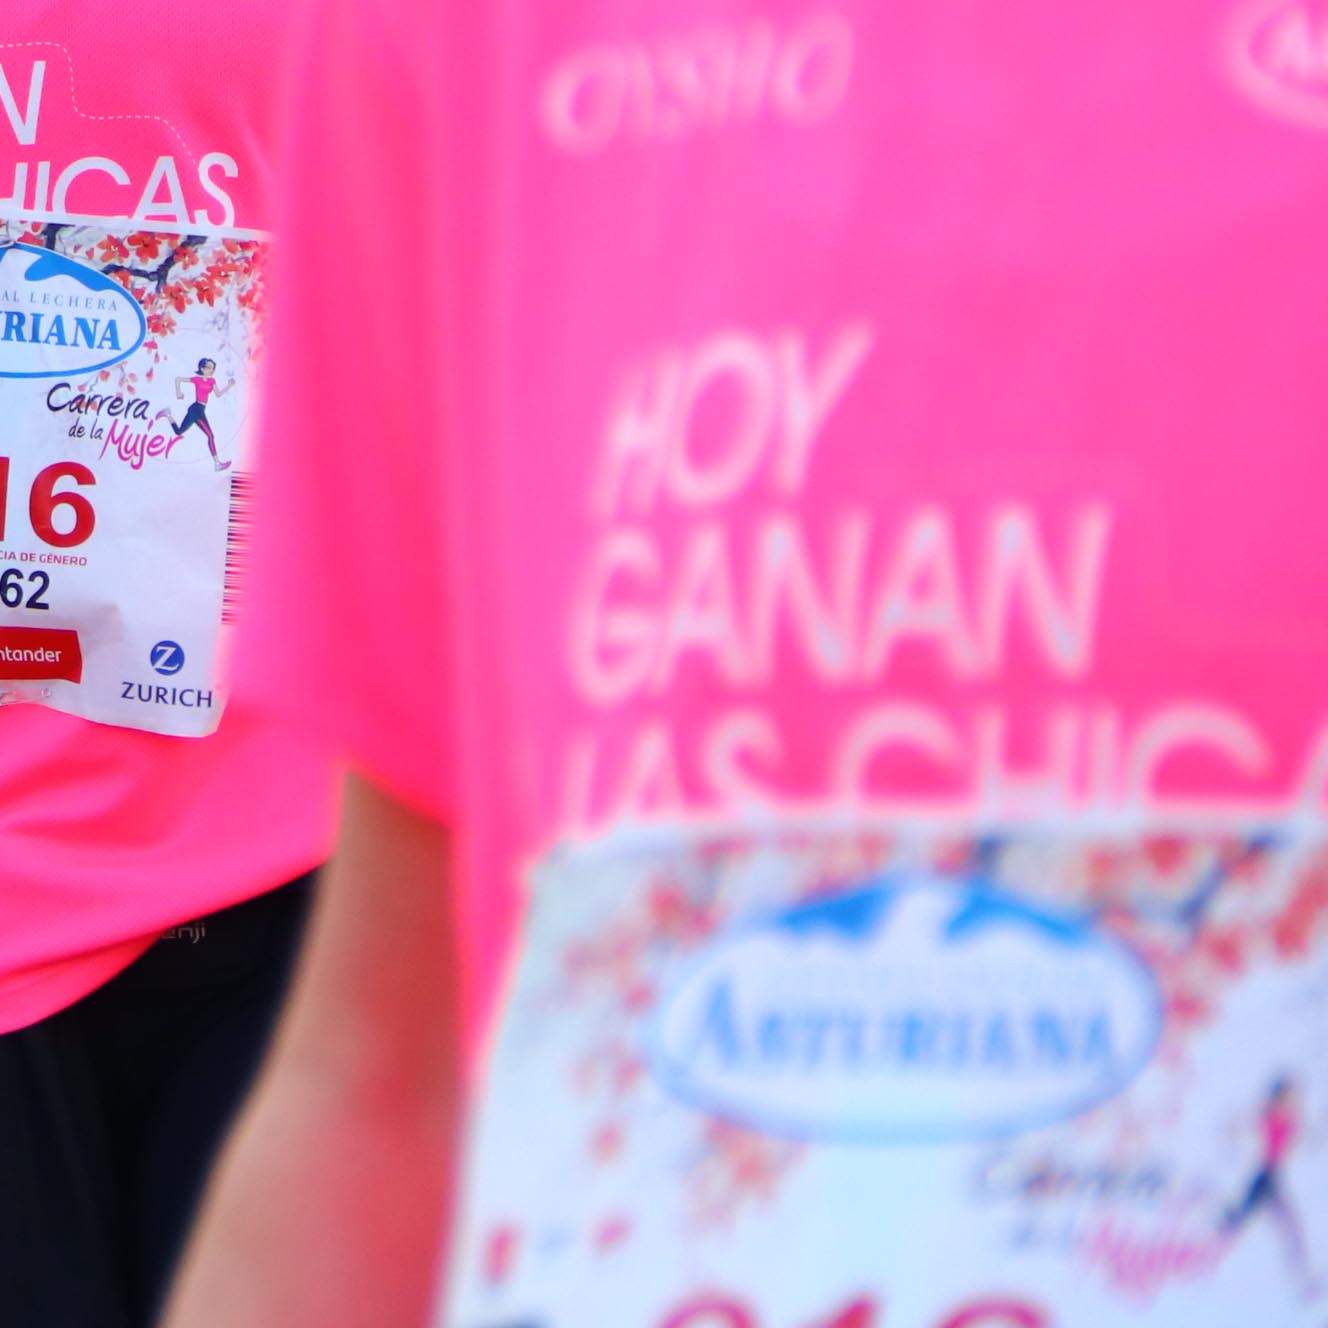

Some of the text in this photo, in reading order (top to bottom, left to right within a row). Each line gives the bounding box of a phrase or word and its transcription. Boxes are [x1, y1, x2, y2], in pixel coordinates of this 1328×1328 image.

[30, 291, 119, 313] LECHERA
[46, 382, 150, 420] Carrera
[593, 318, 875, 522] HOY
[68, 417, 184, 470] de la Mujer
[20, 552, 36, 563] DE
[38, 552, 88, 567] GÉNERO
[570, 500, 1114, 706] GANAN
[120, 680, 213, 709] ZURICH
